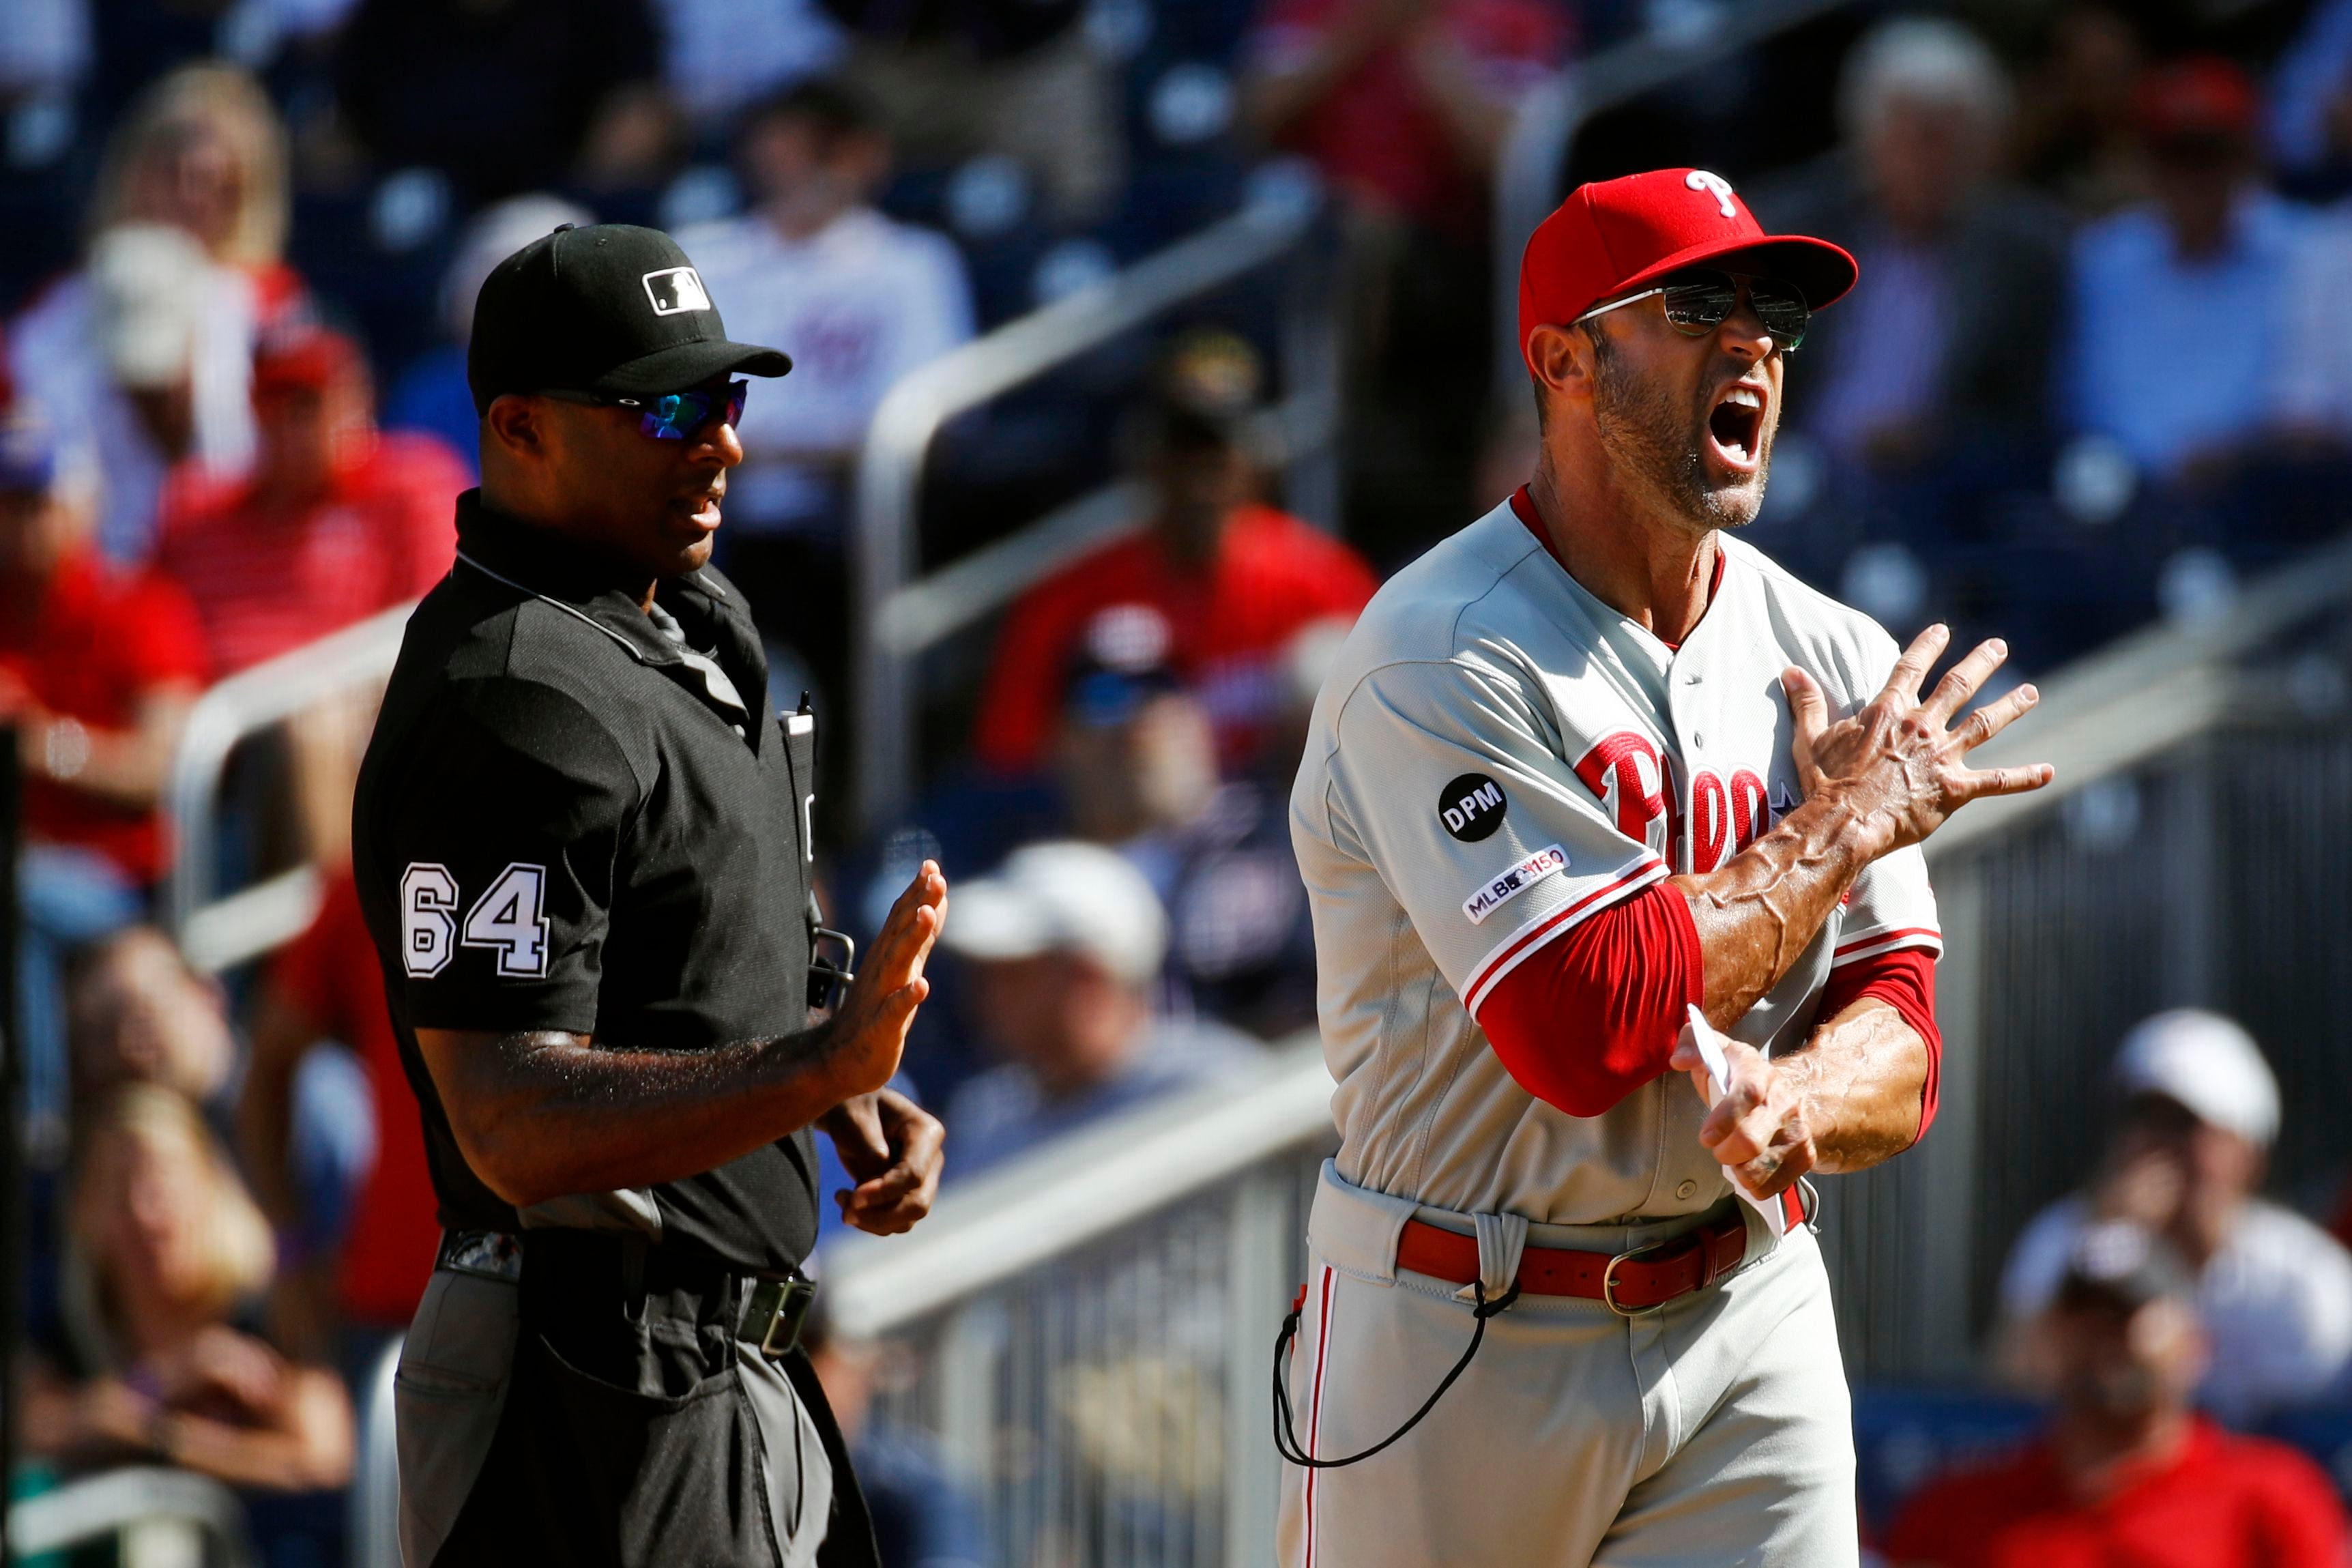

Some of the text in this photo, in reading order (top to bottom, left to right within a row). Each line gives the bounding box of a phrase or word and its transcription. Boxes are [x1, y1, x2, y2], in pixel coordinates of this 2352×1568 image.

[1685, 170, 1736, 218] P
[1442, 781, 1502, 833] DPM
[1468, 850, 1564, 918] MLB 150
[400, 862, 550, 978] 64
